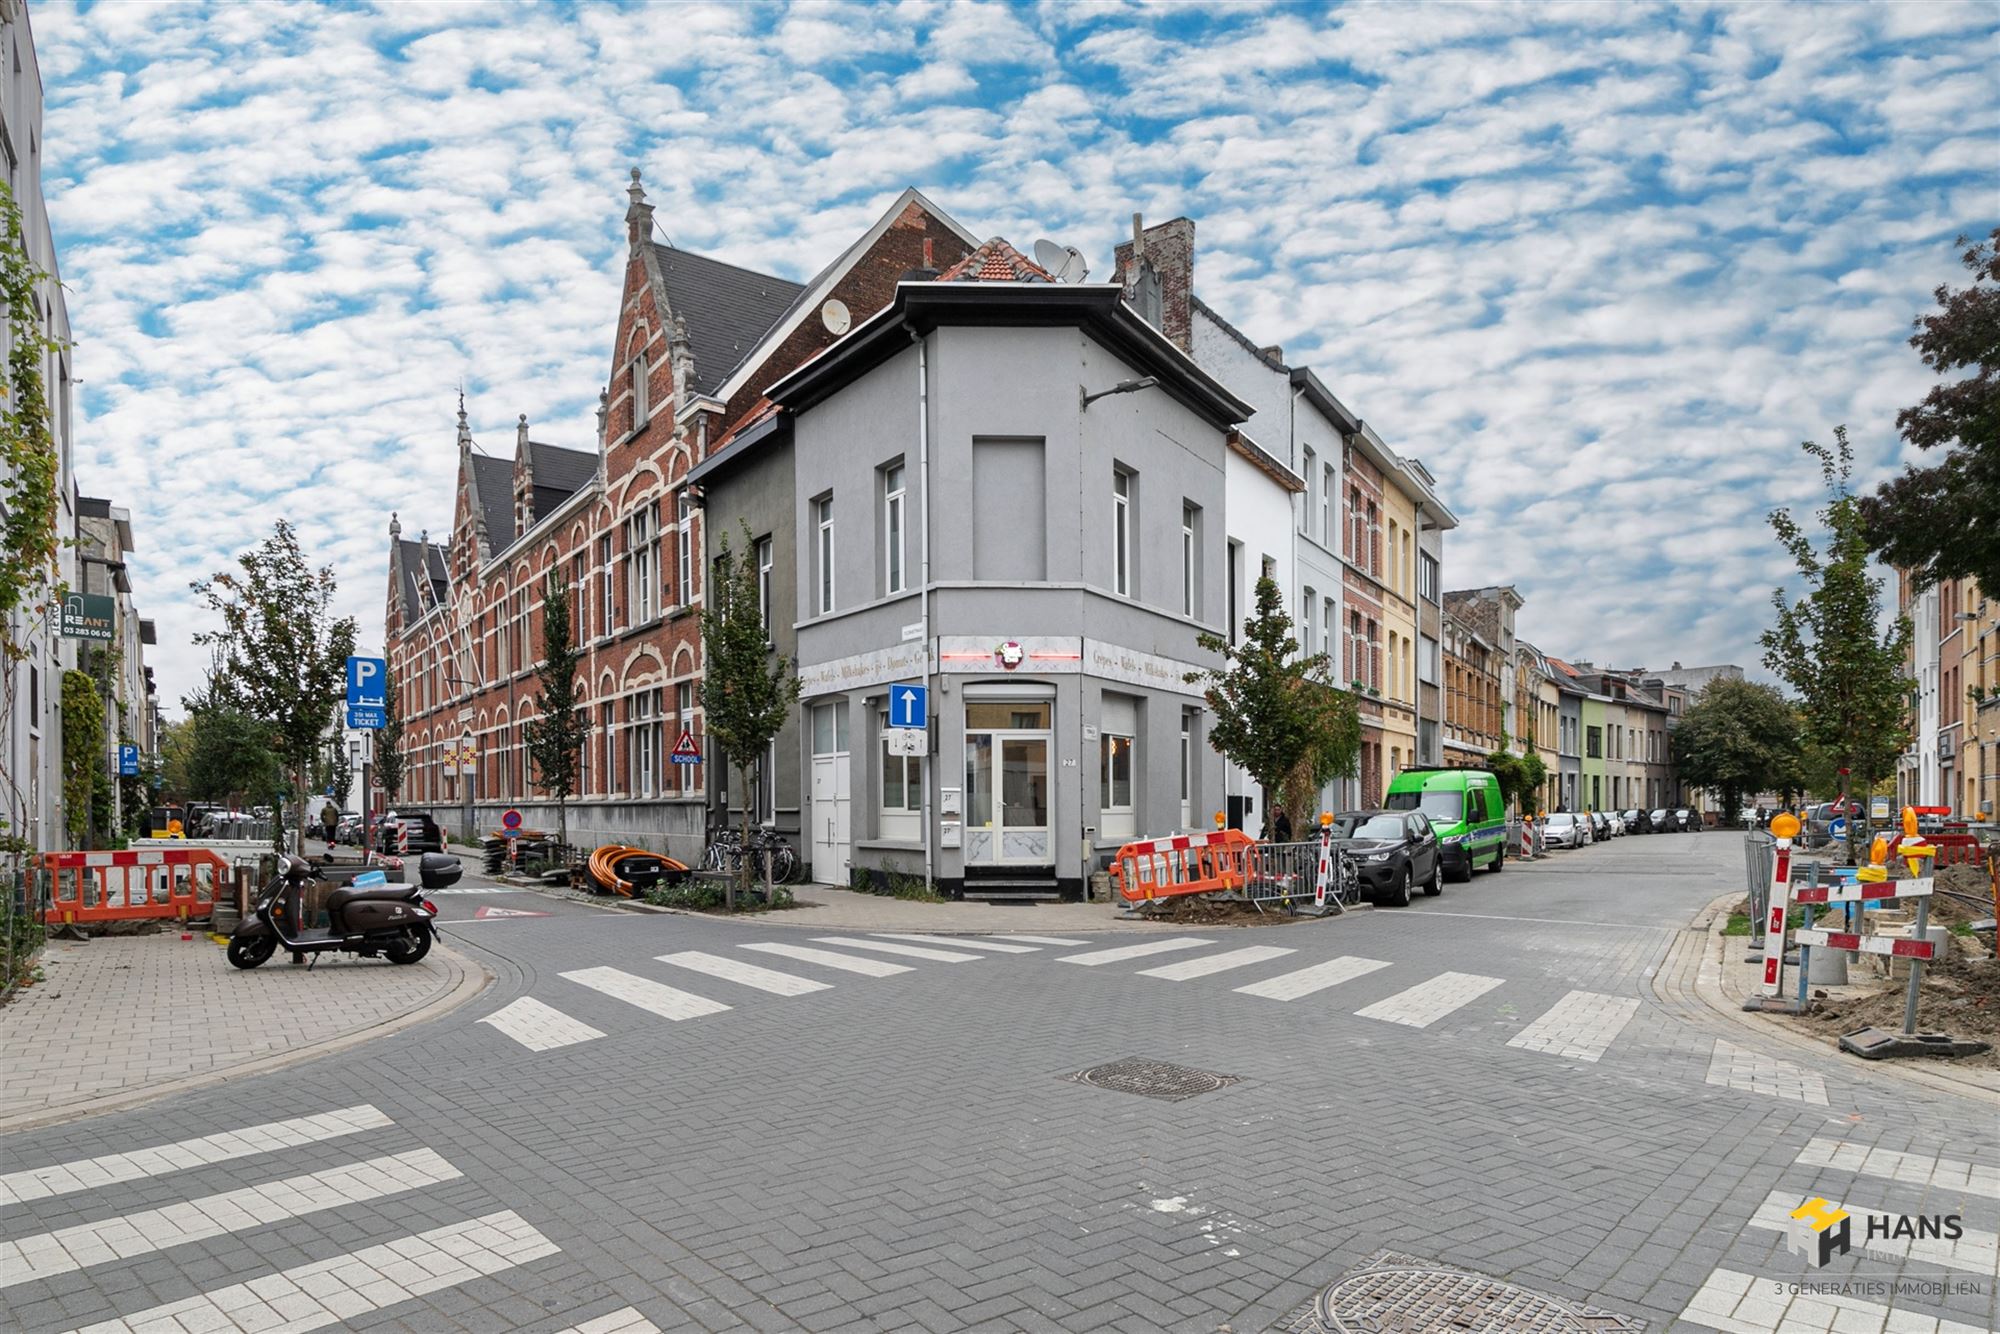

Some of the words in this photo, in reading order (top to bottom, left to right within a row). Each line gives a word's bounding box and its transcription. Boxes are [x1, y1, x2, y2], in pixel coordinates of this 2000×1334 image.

[64, 614, 110, 628] REANT
[64, 626, 74, 634] 03
[75, 628, 90, 636] 283
[90, 629, 101, 637] 06
[101, 630, 112, 638] 06
[357, 661, 377, 687] P
[354, 718, 379, 726] TICKET
[124, 747, 134, 758] P
[674, 755, 699, 764] SCHOOL
